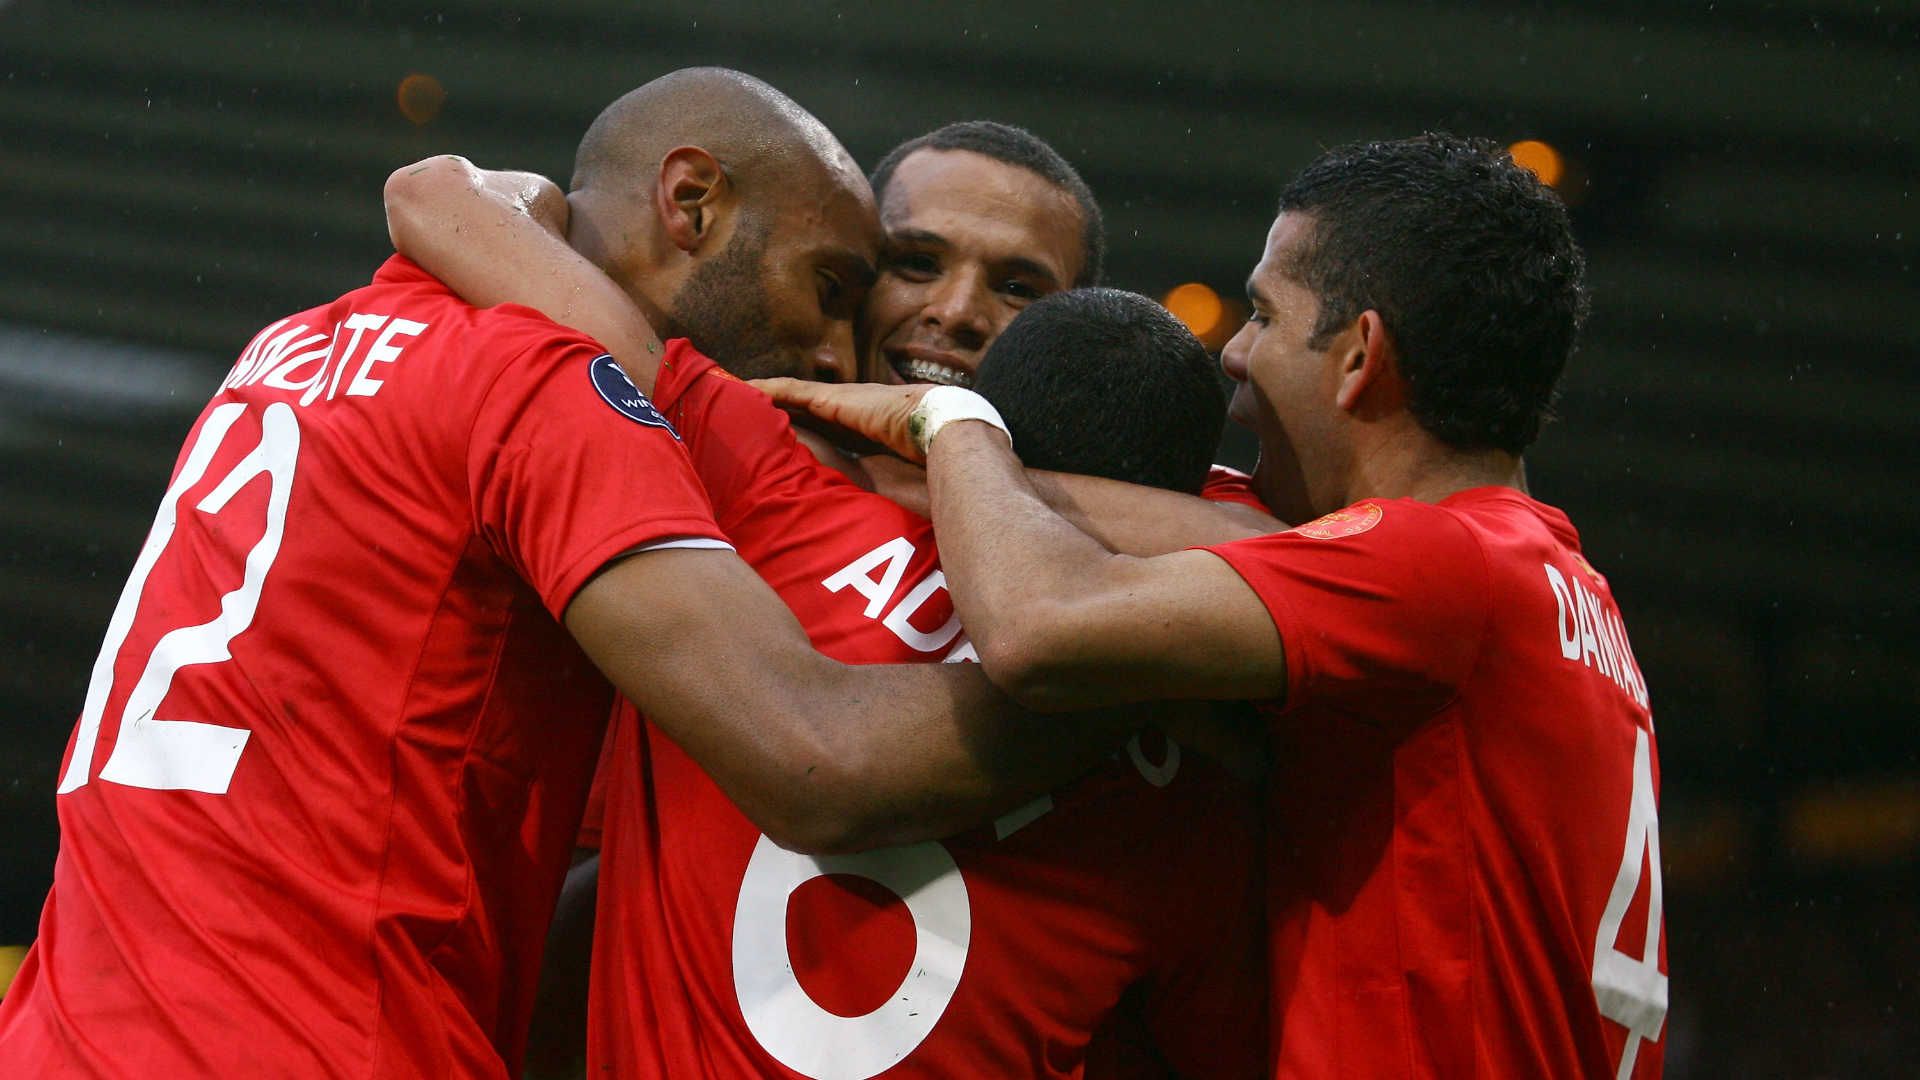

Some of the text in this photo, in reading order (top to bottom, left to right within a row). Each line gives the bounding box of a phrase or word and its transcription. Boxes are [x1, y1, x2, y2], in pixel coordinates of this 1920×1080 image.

[57, 402, 301, 795] 12
[821, 536, 981, 664] AD
[1592, 727, 1669, 1080] 4
